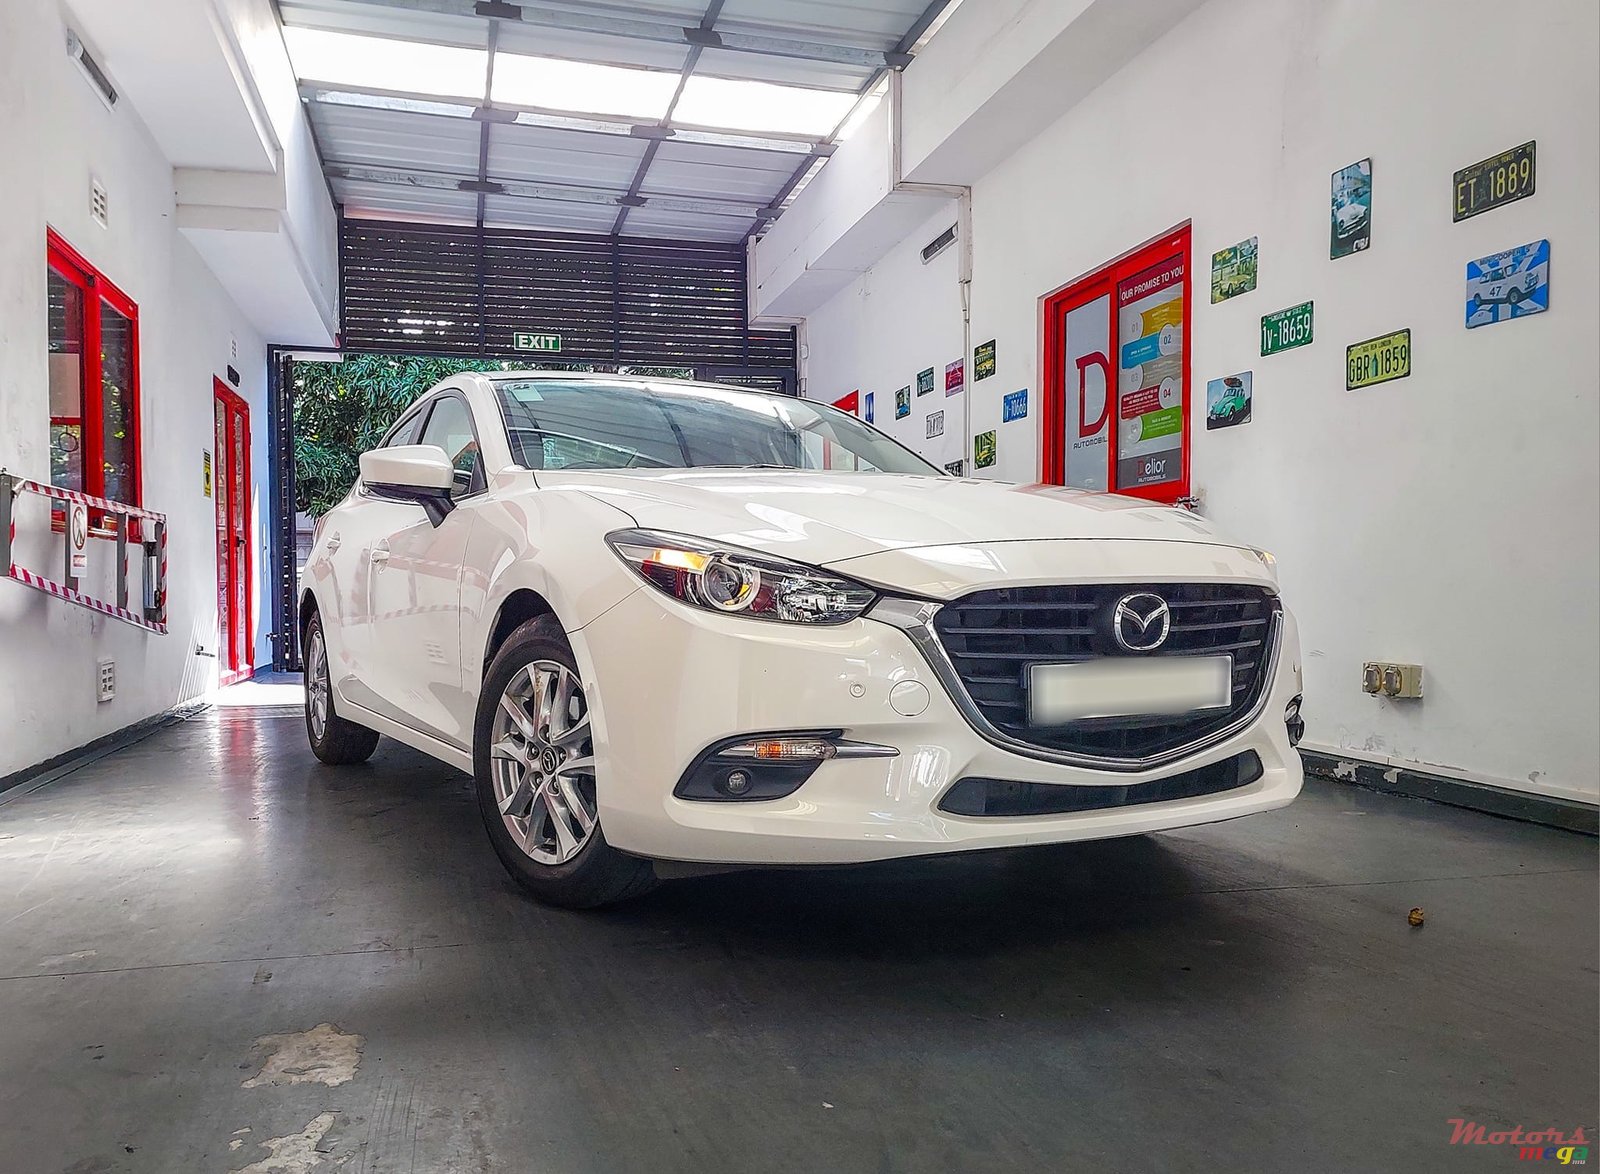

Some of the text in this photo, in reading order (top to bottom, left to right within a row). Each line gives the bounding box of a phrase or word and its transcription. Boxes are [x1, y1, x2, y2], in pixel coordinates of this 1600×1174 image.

[1457, 157, 1530, 214] ET 1889
[1121, 264, 1184, 301] OUR PROMISE TO YOU
[1489, 285, 1502, 298] 47
[1131, 321, 1139, 333] 01
[518, 334, 557, 350] EXIT
[1163, 333, 1172, 346] 02
[1349, 344, 1407, 383] GBR 1859
[1163, 388, 1171, 399] 04
[1137, 457, 1167, 477] Delior
